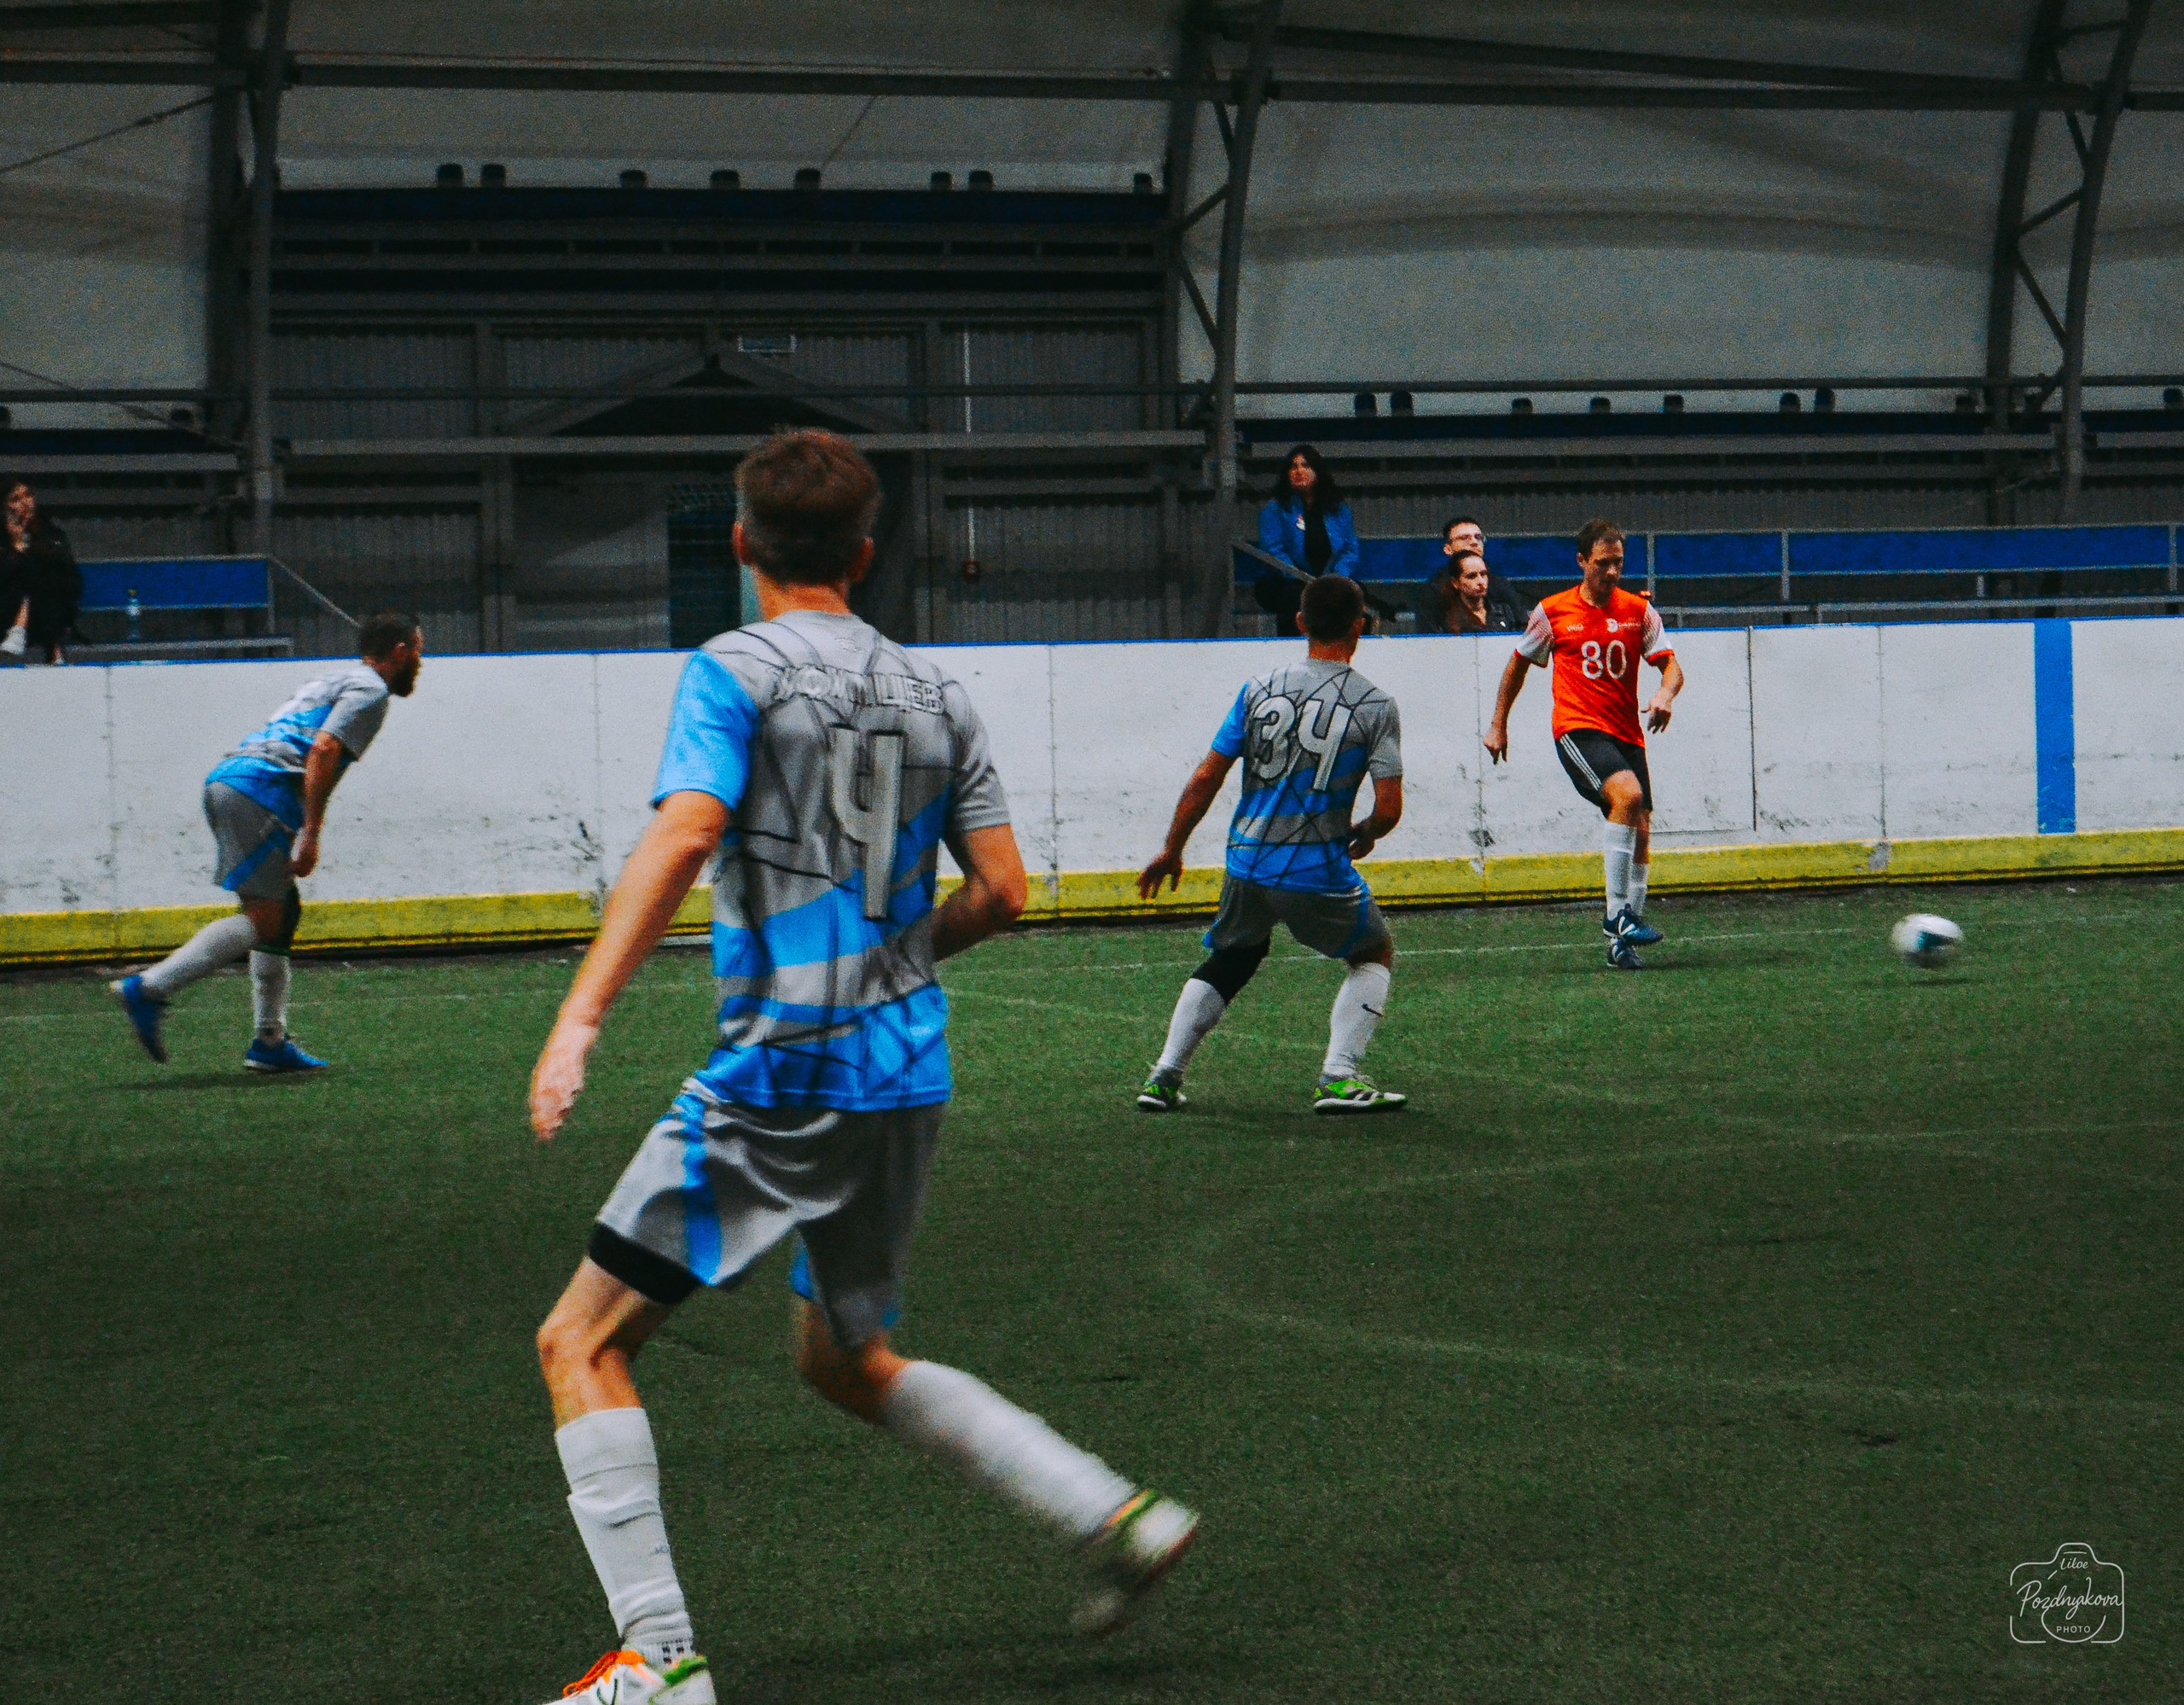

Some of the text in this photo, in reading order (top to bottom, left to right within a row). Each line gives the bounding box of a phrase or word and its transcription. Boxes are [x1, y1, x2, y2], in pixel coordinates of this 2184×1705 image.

[1581, 640, 1627, 679] 80
[1250, 695, 1353, 792] 34
[827, 724, 906, 920] 4
